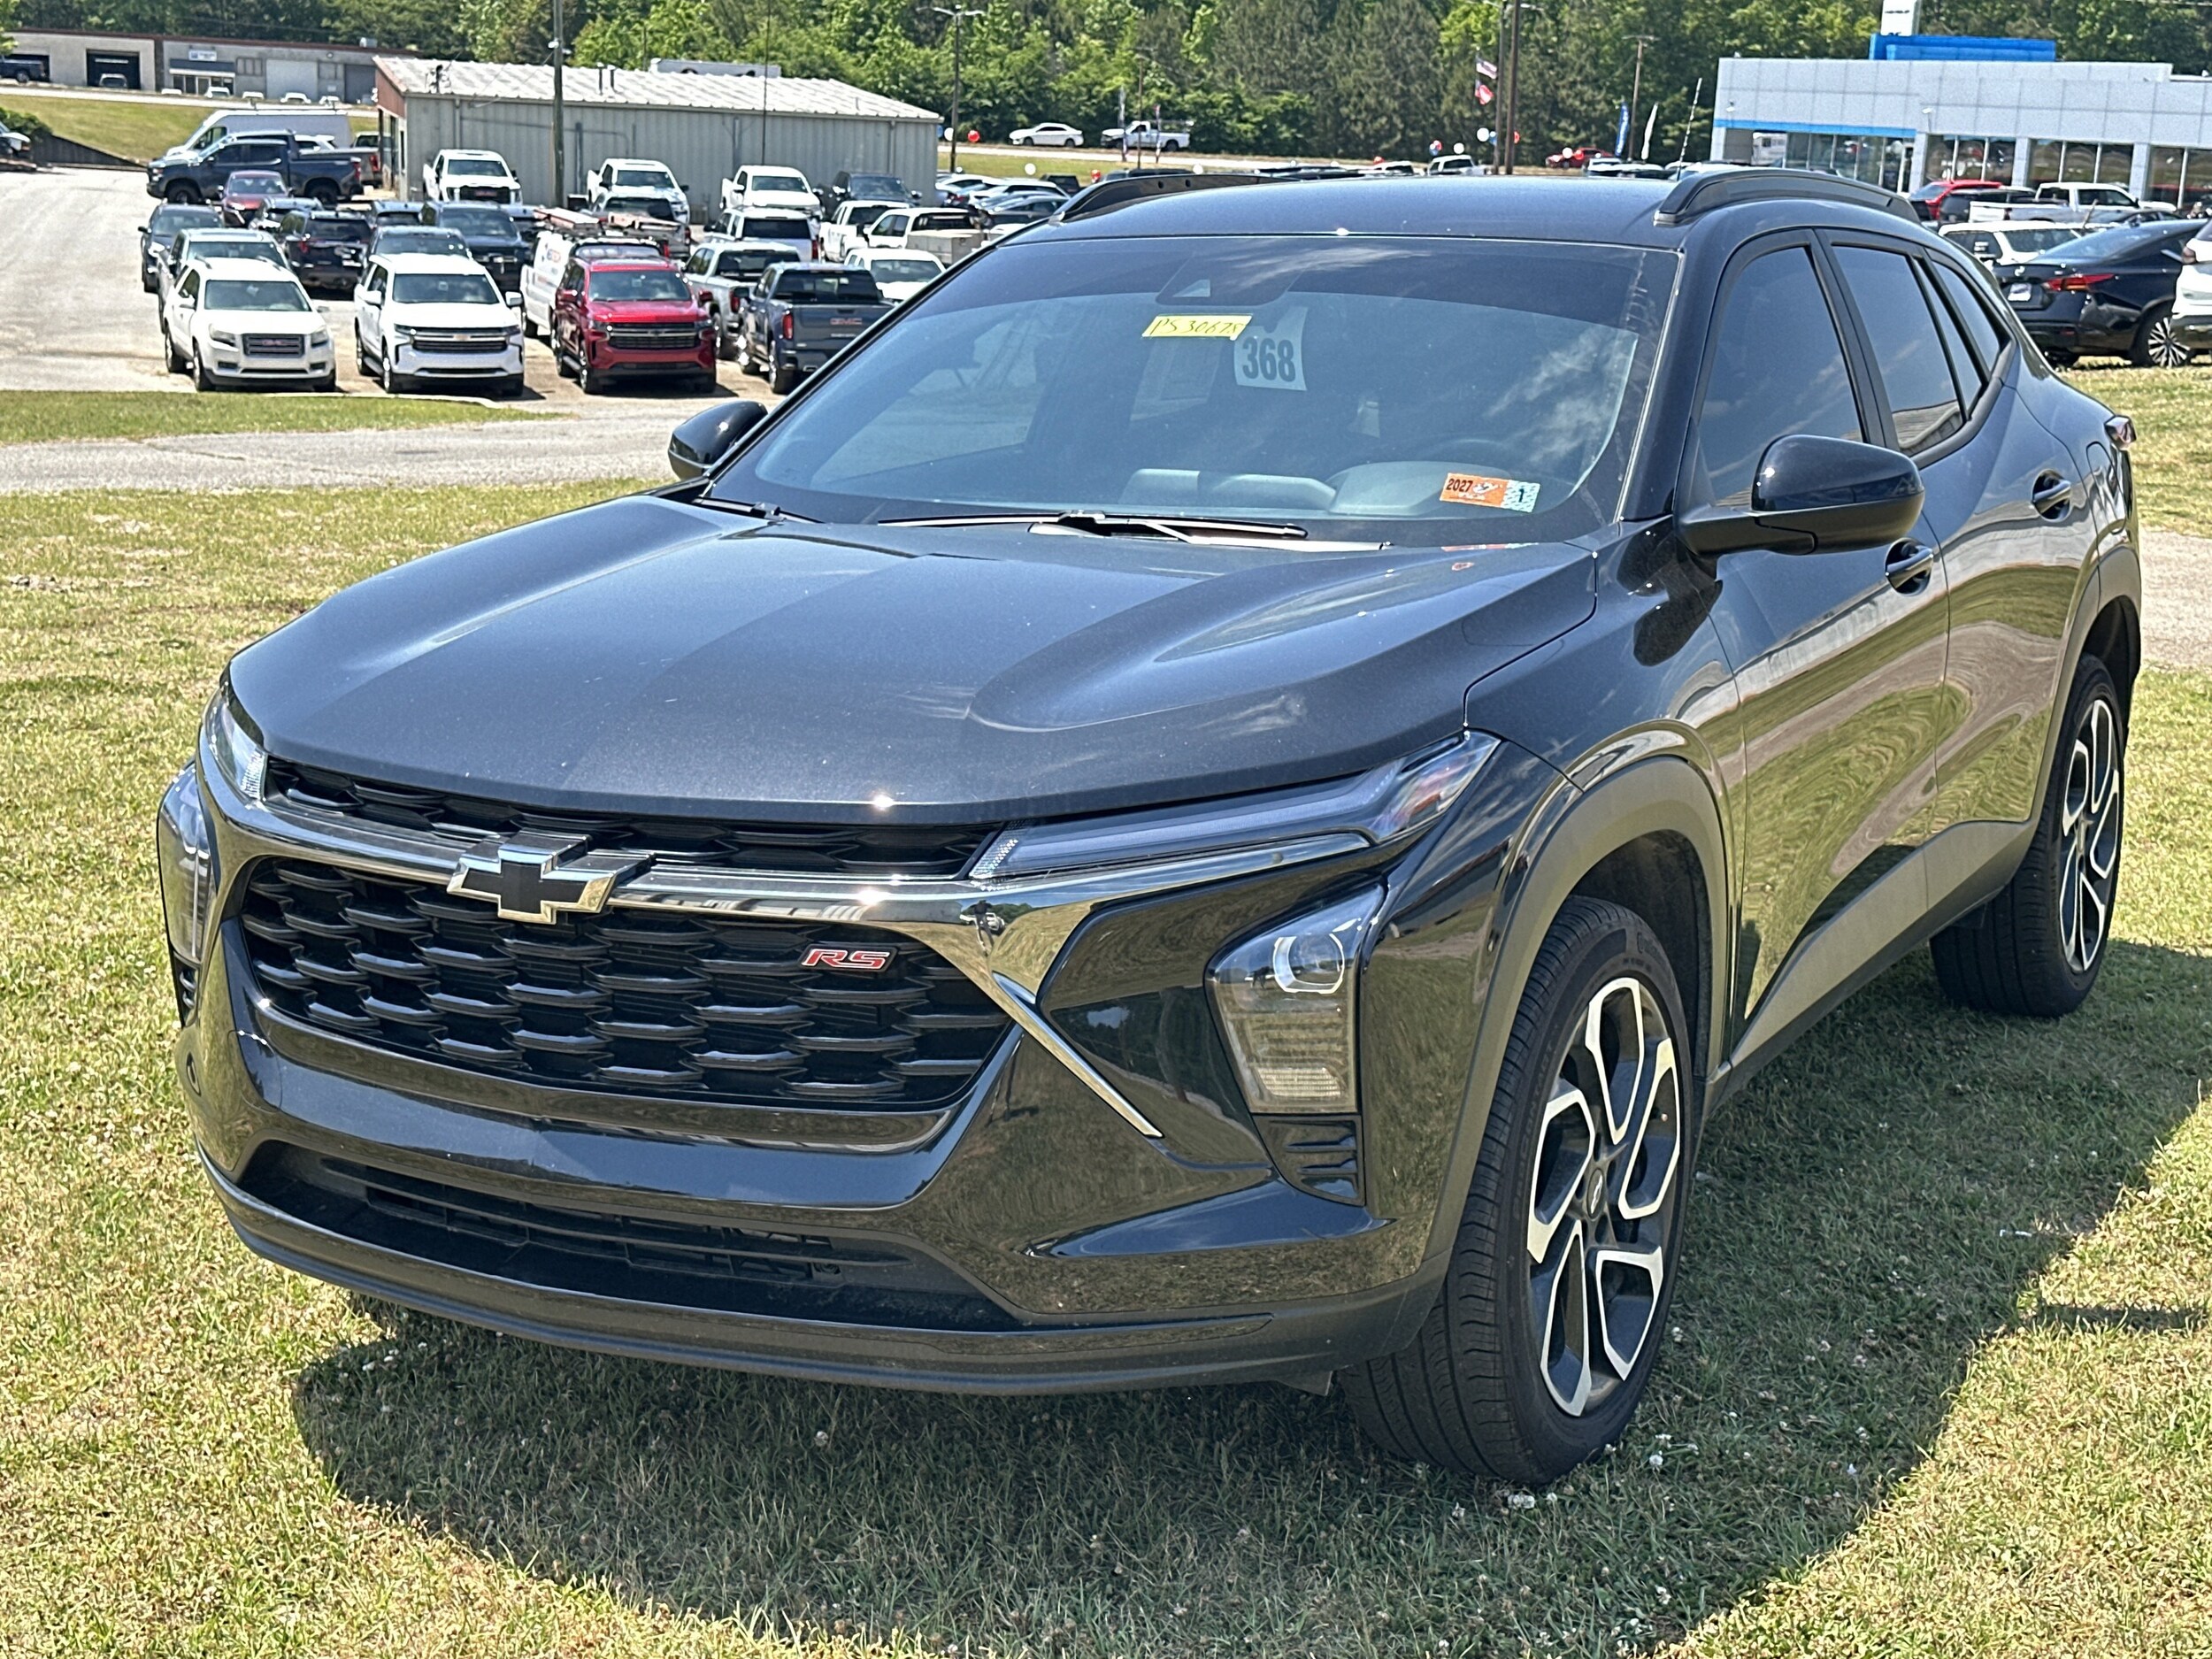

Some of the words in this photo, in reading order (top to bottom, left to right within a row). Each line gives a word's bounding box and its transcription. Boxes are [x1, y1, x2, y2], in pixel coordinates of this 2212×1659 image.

[1241, 336, 1296, 382] 368
[1446, 478, 1473, 492] 2027
[801, 949, 890, 969] RS
